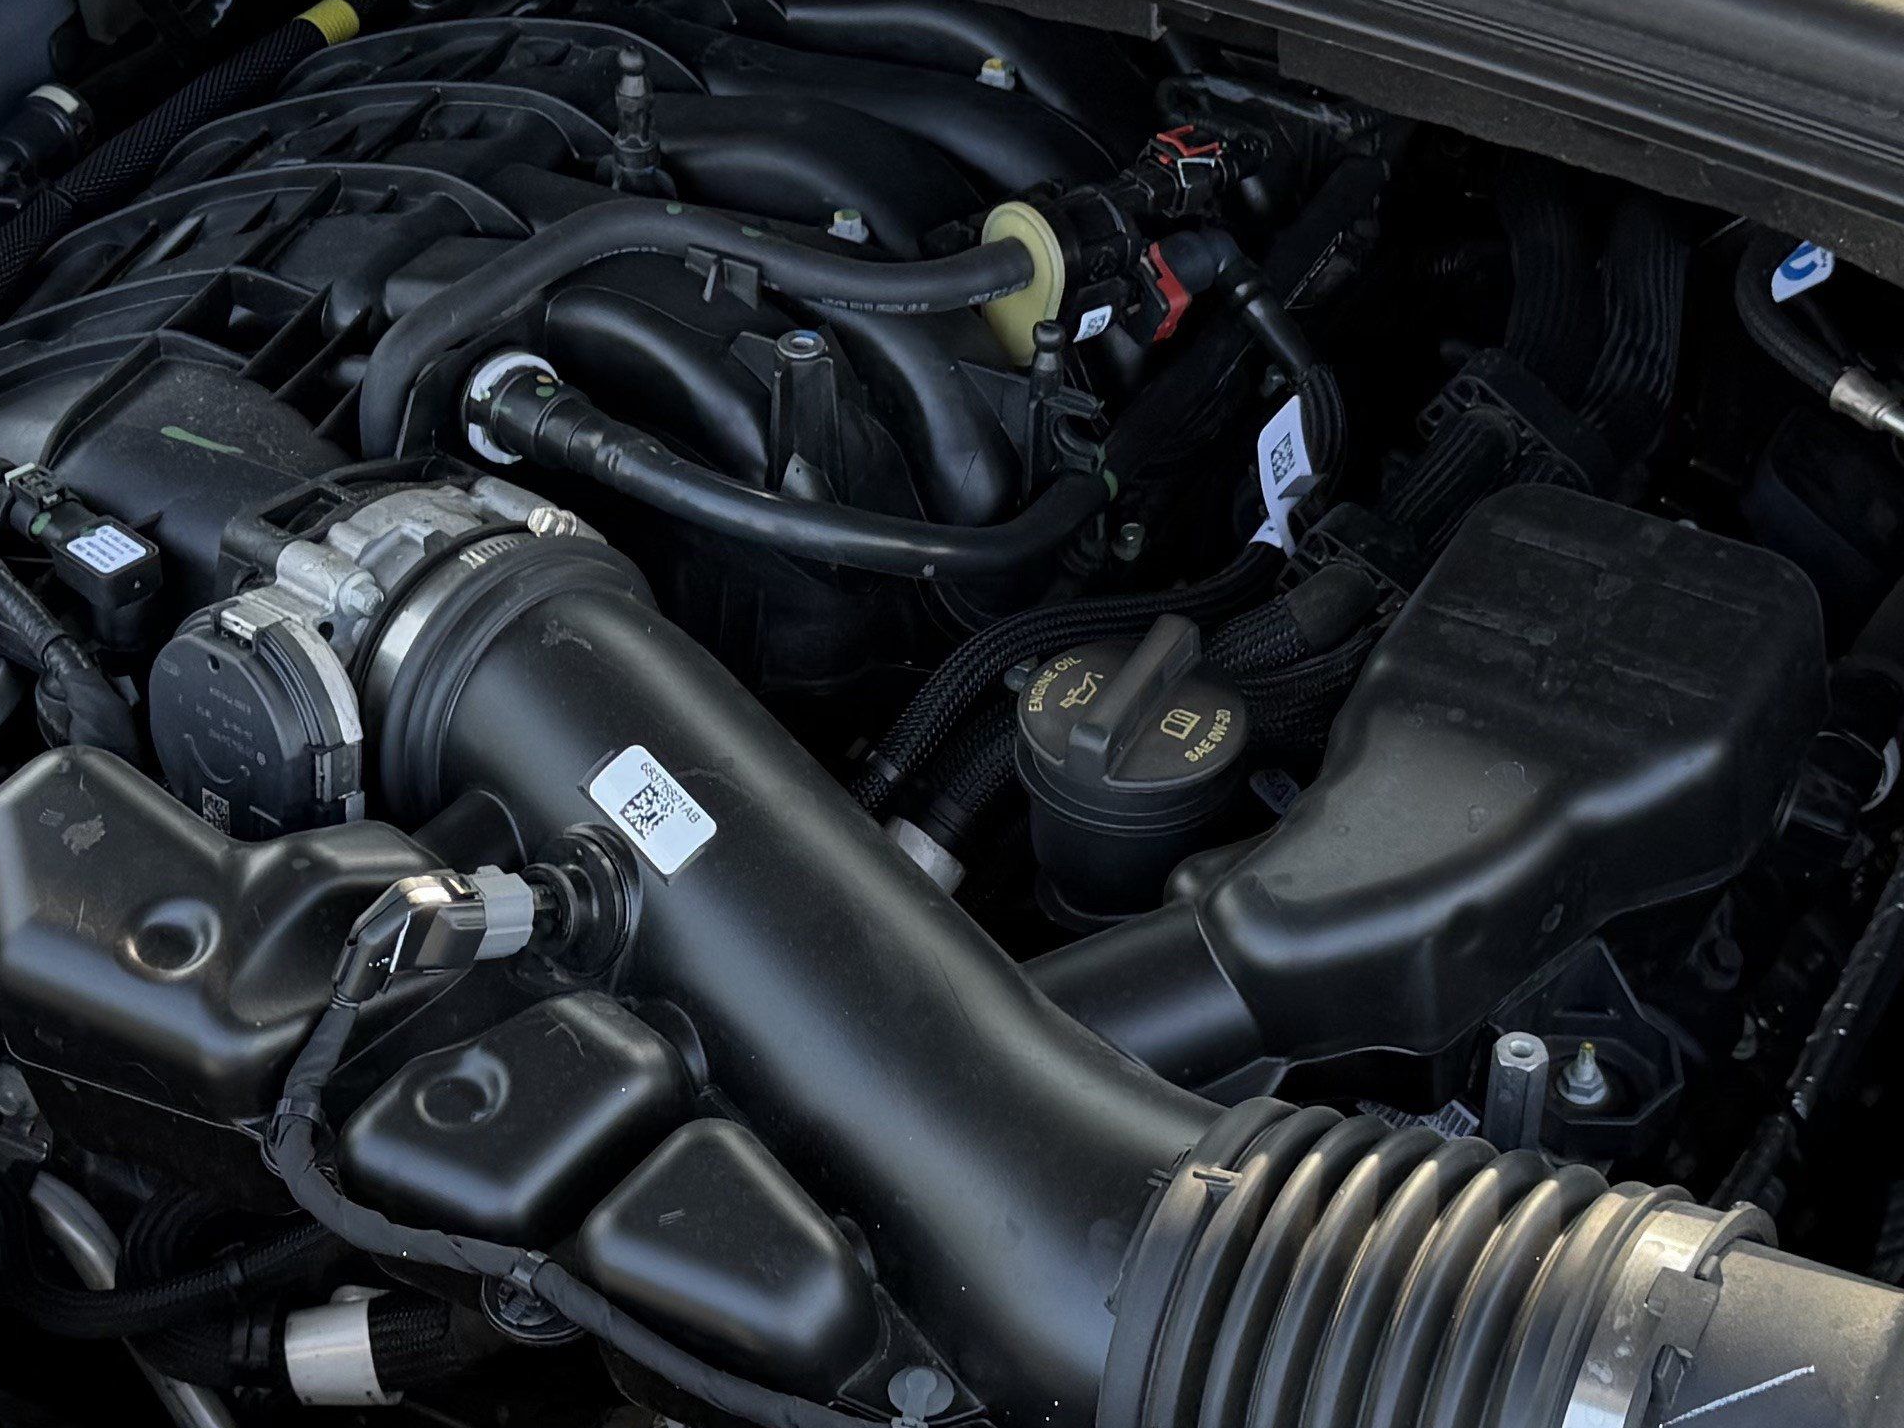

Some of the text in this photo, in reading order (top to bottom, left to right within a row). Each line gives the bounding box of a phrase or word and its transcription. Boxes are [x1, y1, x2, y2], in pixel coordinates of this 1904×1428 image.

[1028, 656, 1082, 712] ENGINE OIL
[1184, 709, 1231, 762] SAE 0W-20
